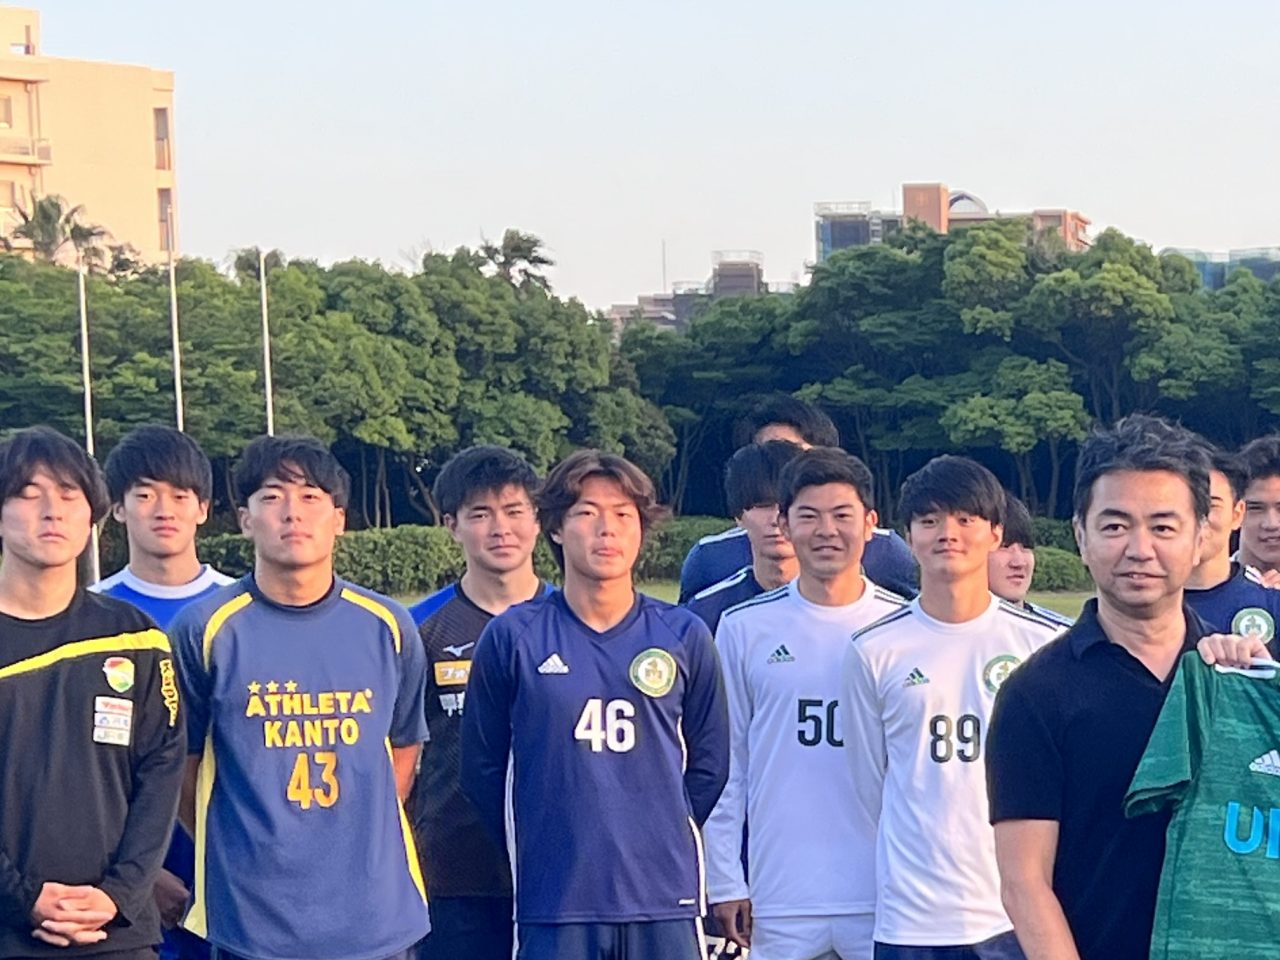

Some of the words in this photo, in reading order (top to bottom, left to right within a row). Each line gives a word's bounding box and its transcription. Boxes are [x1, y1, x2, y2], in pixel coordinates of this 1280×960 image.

[246, 691, 372, 717] ATHLETA
[574, 698, 636, 752] 46
[264, 717, 359, 748] KANTO
[929, 714, 981, 763] 89
[287, 752, 339, 810] 43
